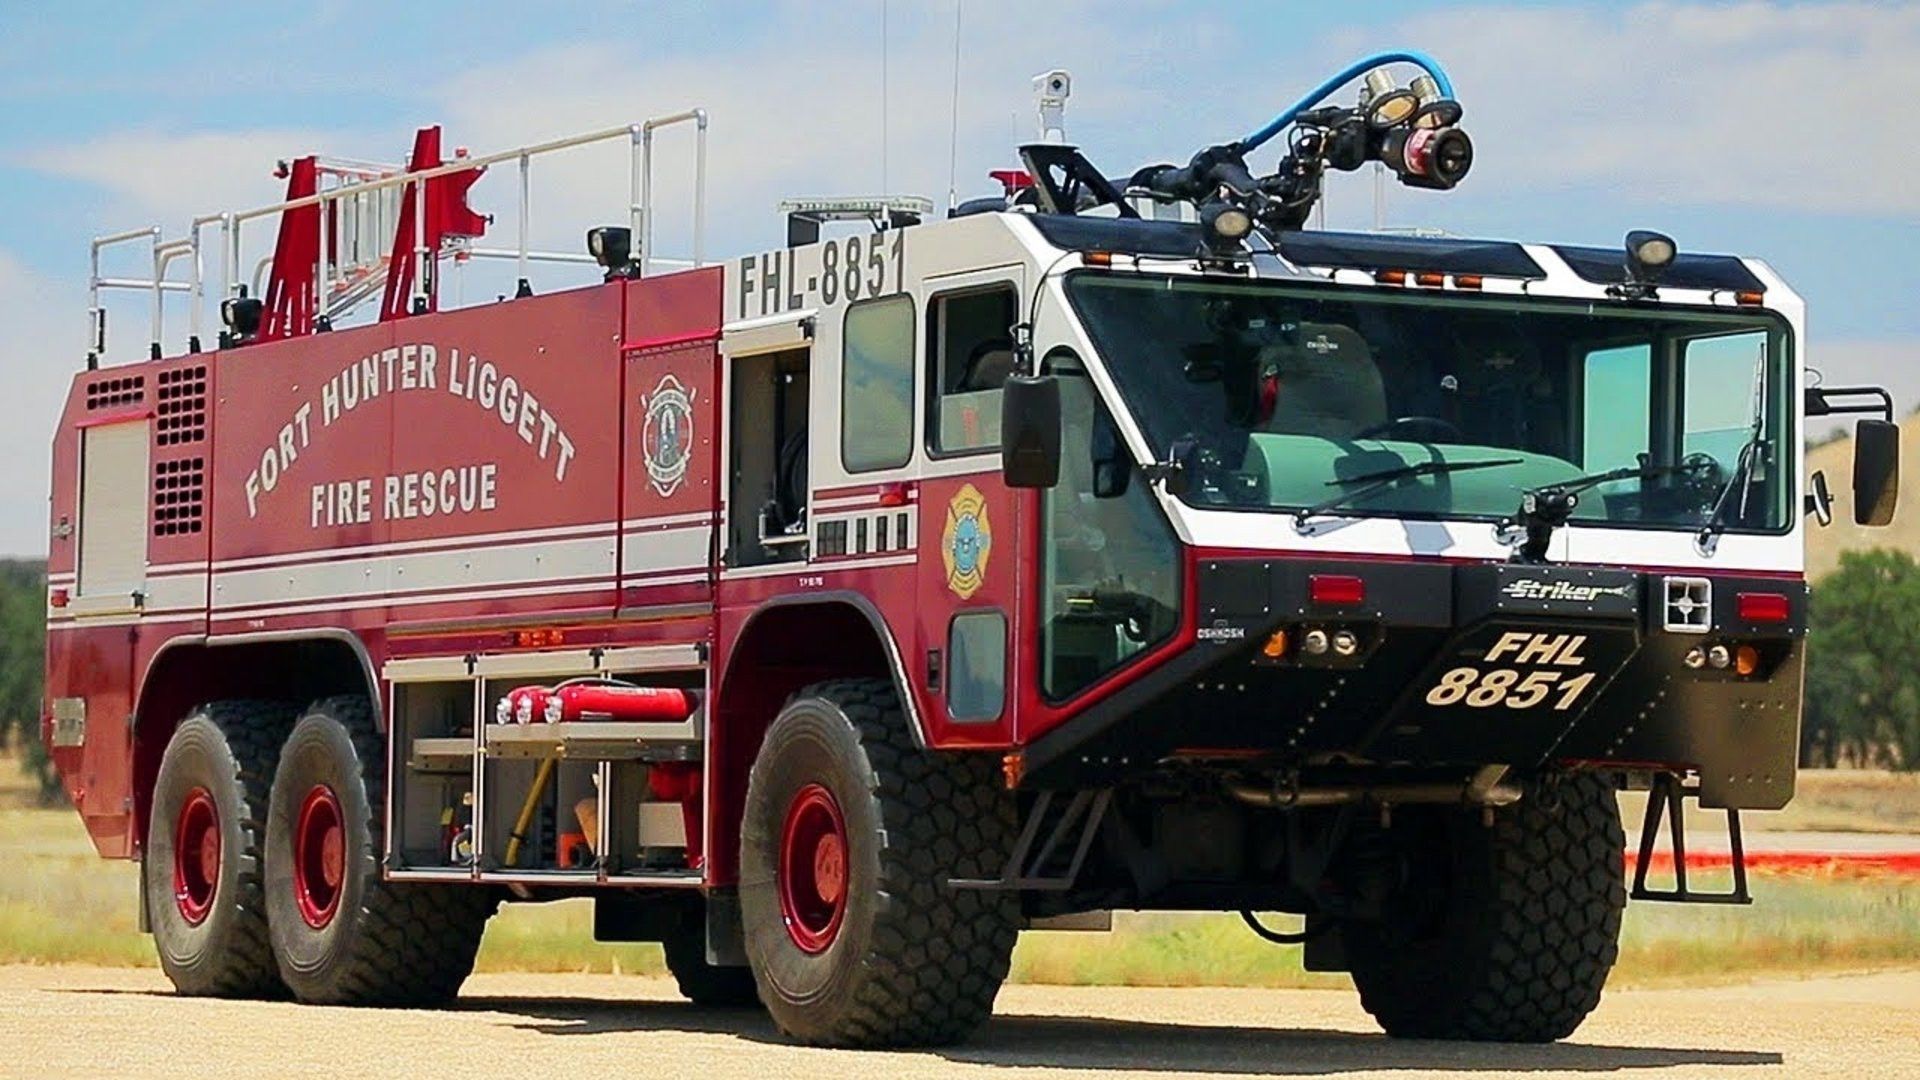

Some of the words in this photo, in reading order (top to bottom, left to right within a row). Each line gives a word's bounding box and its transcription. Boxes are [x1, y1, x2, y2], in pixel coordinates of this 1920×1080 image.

[740, 228, 904, 318] FHL-8851
[244, 401, 312, 518] FORT
[322, 344, 437, 427] HUNTER
[448, 349, 575, 482] LIGGETT
[311, 479, 372, 528] FIRE
[384, 464, 496, 520] RESCUE
[1502, 579, 1603, 600] Striker
[1484, 631, 1587, 665] FHL
[1426, 667, 1596, 710] 8851
